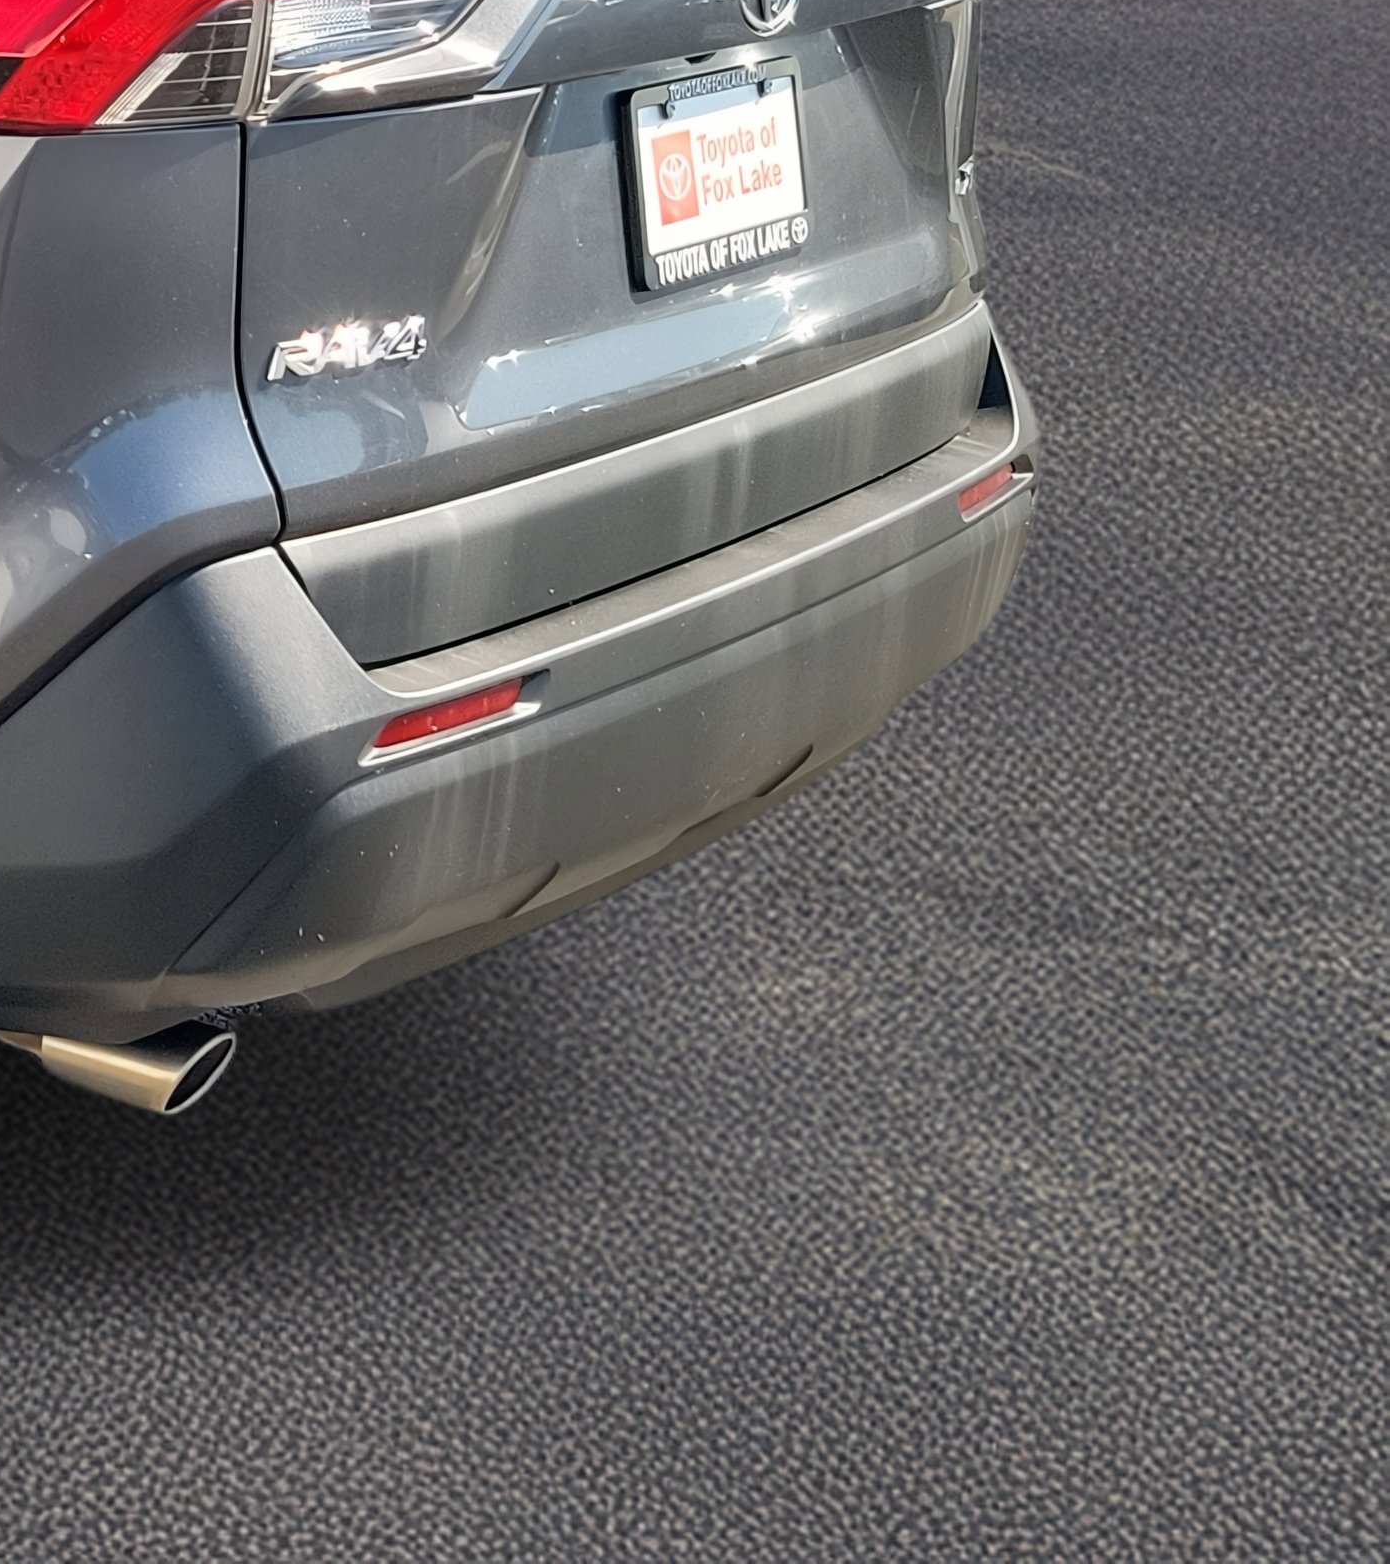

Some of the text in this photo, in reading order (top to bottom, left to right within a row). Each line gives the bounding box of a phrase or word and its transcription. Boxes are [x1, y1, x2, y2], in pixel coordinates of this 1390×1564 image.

[697, 117, 777, 168] Toyota of
[701, 159, 783, 206] Fox Lake
[655, 219, 792, 286] TOYOTA OF FOX LAKE
[266, 314, 428, 382] RAV4
